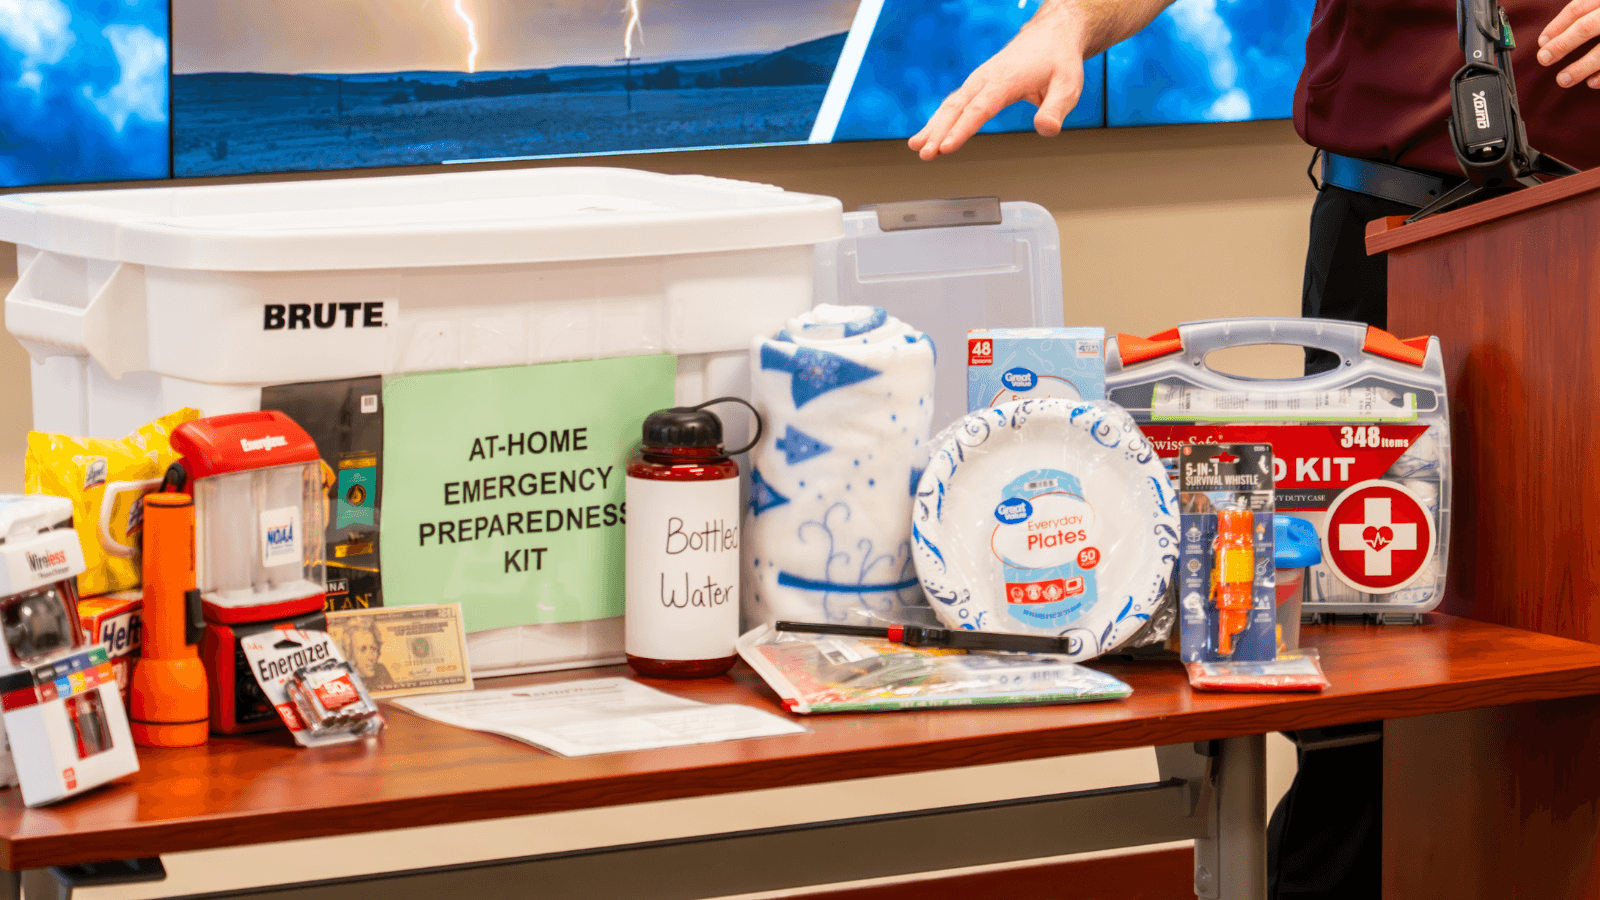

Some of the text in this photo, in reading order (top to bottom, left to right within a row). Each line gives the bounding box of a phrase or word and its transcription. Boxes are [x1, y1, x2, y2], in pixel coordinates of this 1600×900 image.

[1472, 91, 1490, 129] auray
[972, 341, 992, 356] 48
[1004, 372, 1032, 382] Great
[469, 428, 588, 461] AT-HOME
[1146, 435, 1184, 451] Swiss
[1341, 426, 1380, 448] 348
[1185, 462, 1219, 476] 5-IN-1
[1296, 457, 1356, 482] KIT
[444, 466, 614, 506] EMERGENCY
[1185, 474, 1259, 486] SURVIVAL WHISTLE
[1285, 494, 1306, 502] DUTY
[1307, 494, 1326, 502] CASE
[998, 503, 1027, 516] Great
[1004, 511, 1028, 521] Value
[1027, 514, 1084, 532] Everyday
[267, 525, 293, 544] NOAA
[1027, 529, 1087, 551] Plates
[26, 550, 67, 572] Wireless
[504, 548, 548, 573] KIT
[1080, 550, 1096, 563] 50
[661, 572, 733, 608] Water
[103, 614, 142, 653] Heft
[258, 641, 331, 682] Energizer
